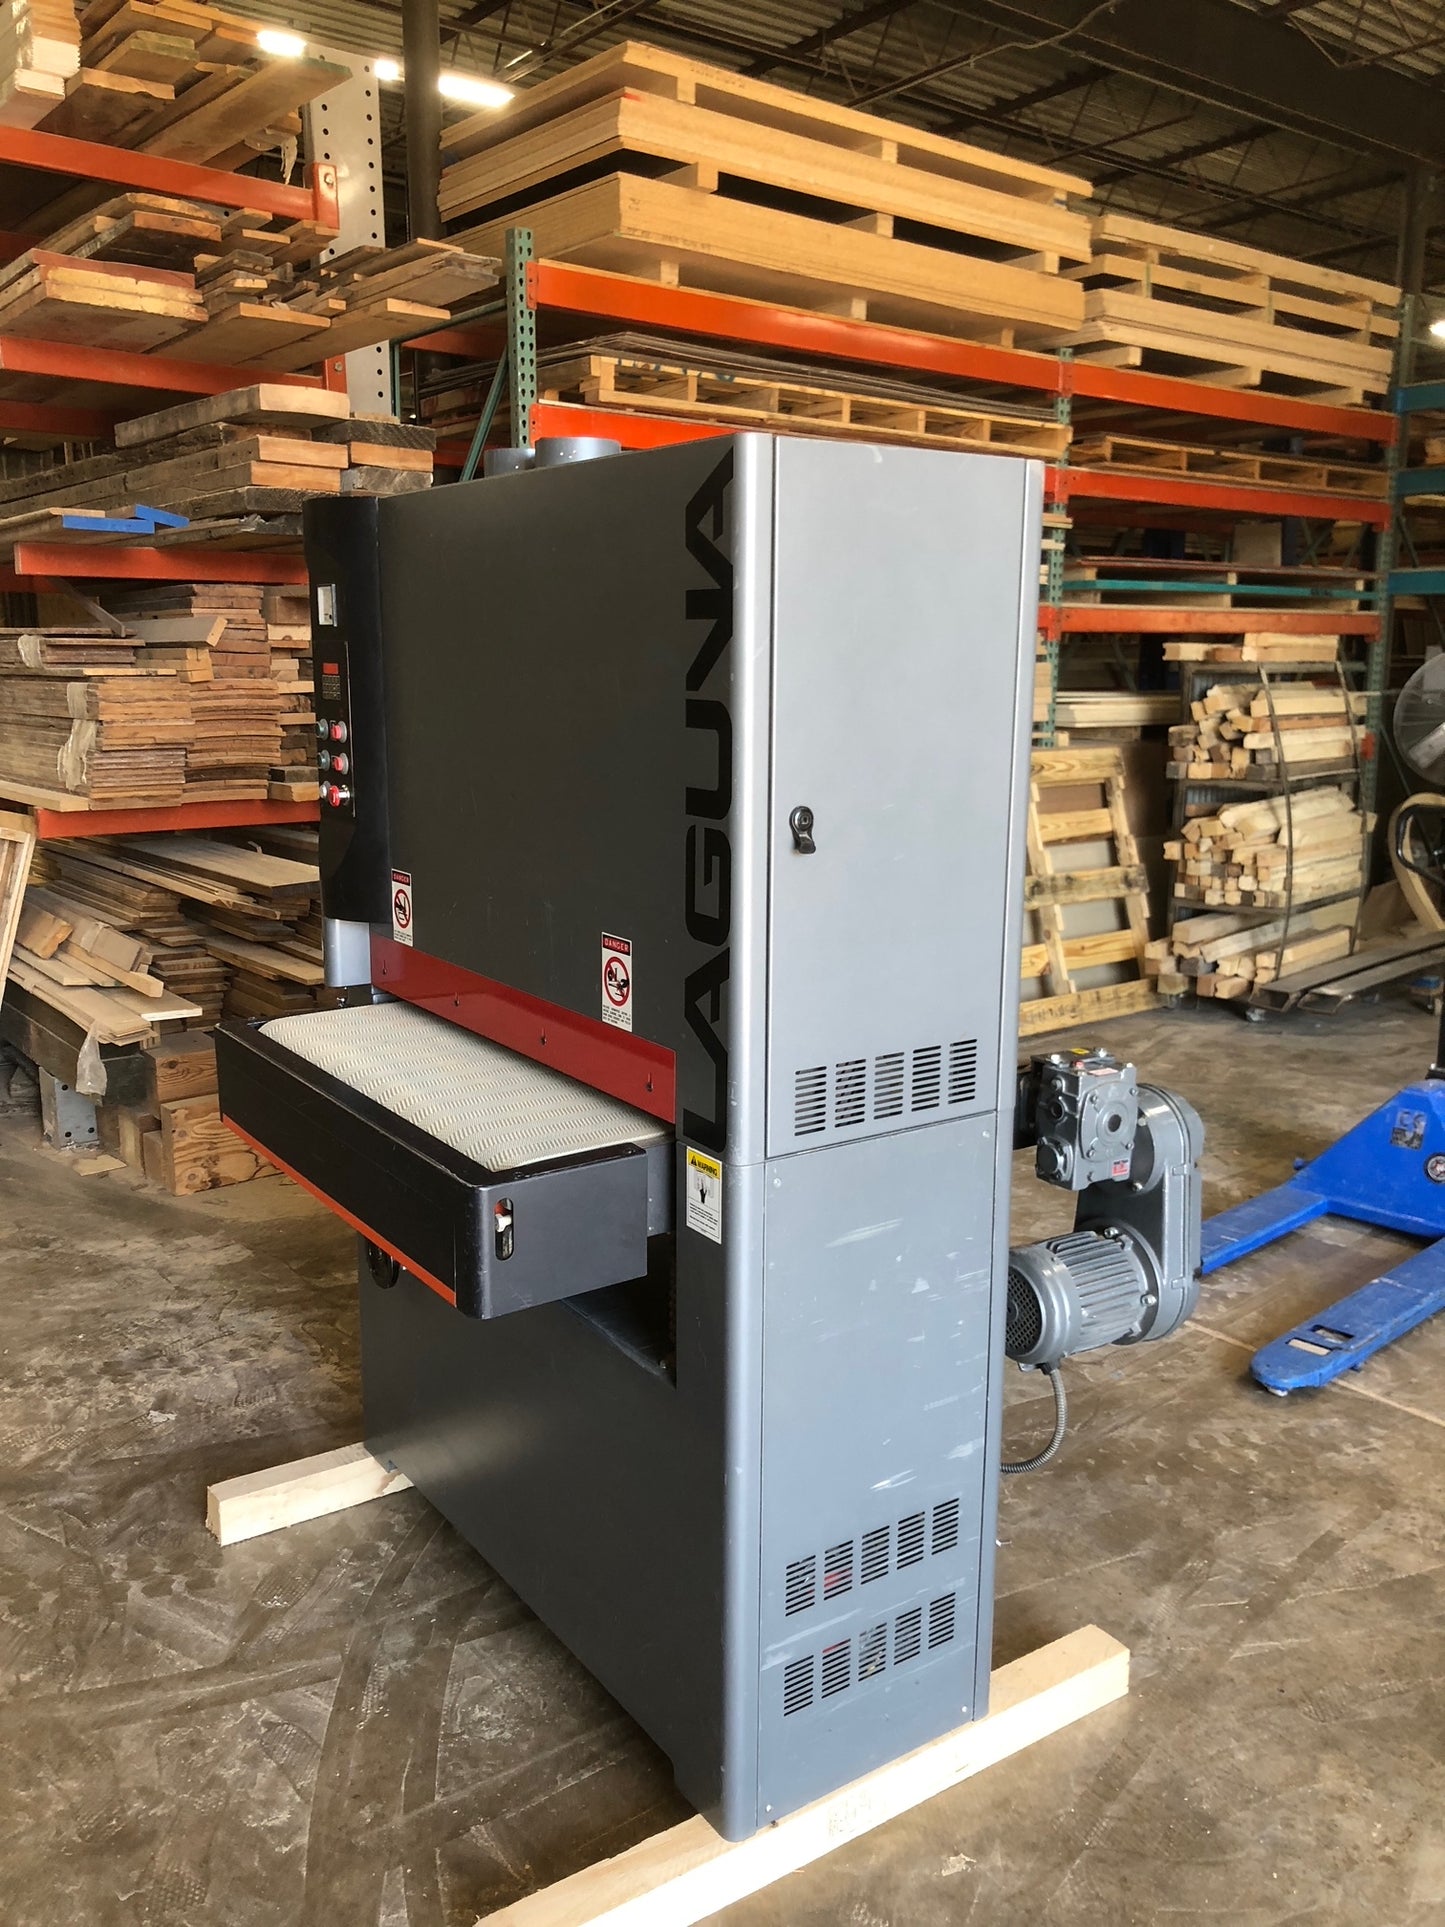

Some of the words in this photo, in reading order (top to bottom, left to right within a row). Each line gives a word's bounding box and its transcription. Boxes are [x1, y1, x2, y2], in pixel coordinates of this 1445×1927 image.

[683, 446, 734, 1153] LAGUNA
[393, 872, 409, 884] DANGER
[604, 937, 629, 953] DANGER
[697, 1160, 718, 1177] WARNING
